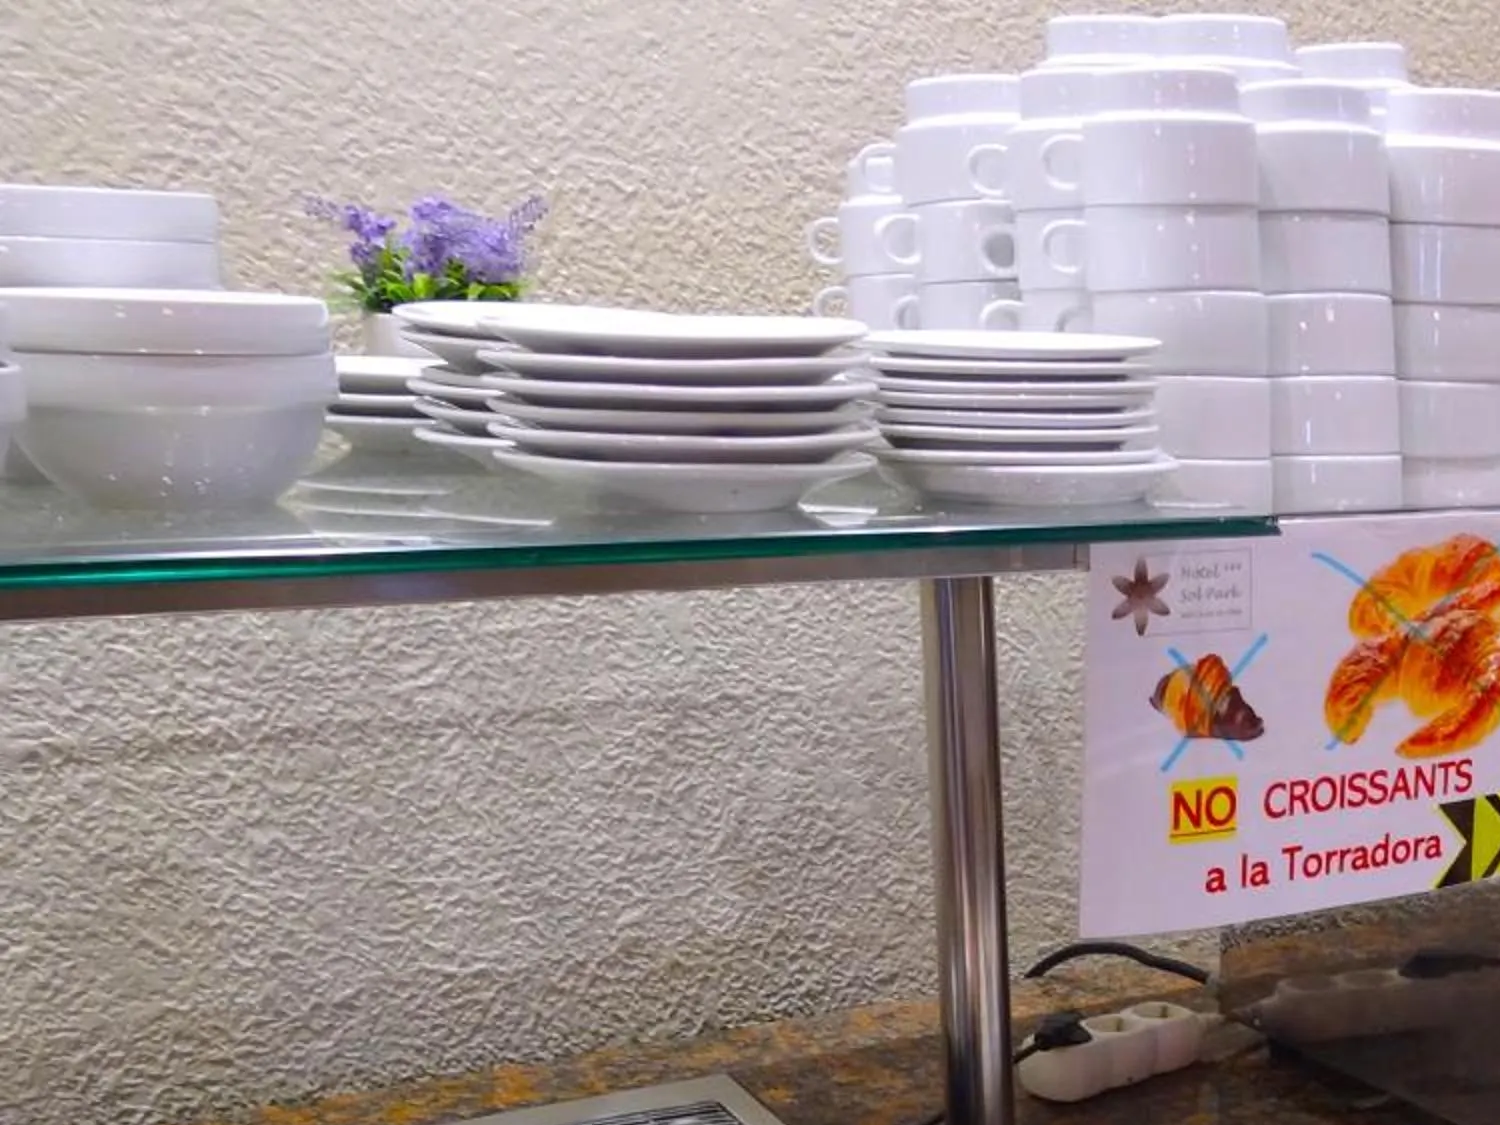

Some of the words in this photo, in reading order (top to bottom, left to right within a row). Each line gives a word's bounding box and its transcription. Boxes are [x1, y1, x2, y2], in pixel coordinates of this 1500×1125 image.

[1172, 786, 1237, 832] NO
[1263, 759, 1474, 820] CROISSANTS
[1204, 865, 1227, 894] a
[1240, 853, 1270, 889] la
[1281, 832, 1443, 882] Torradora
